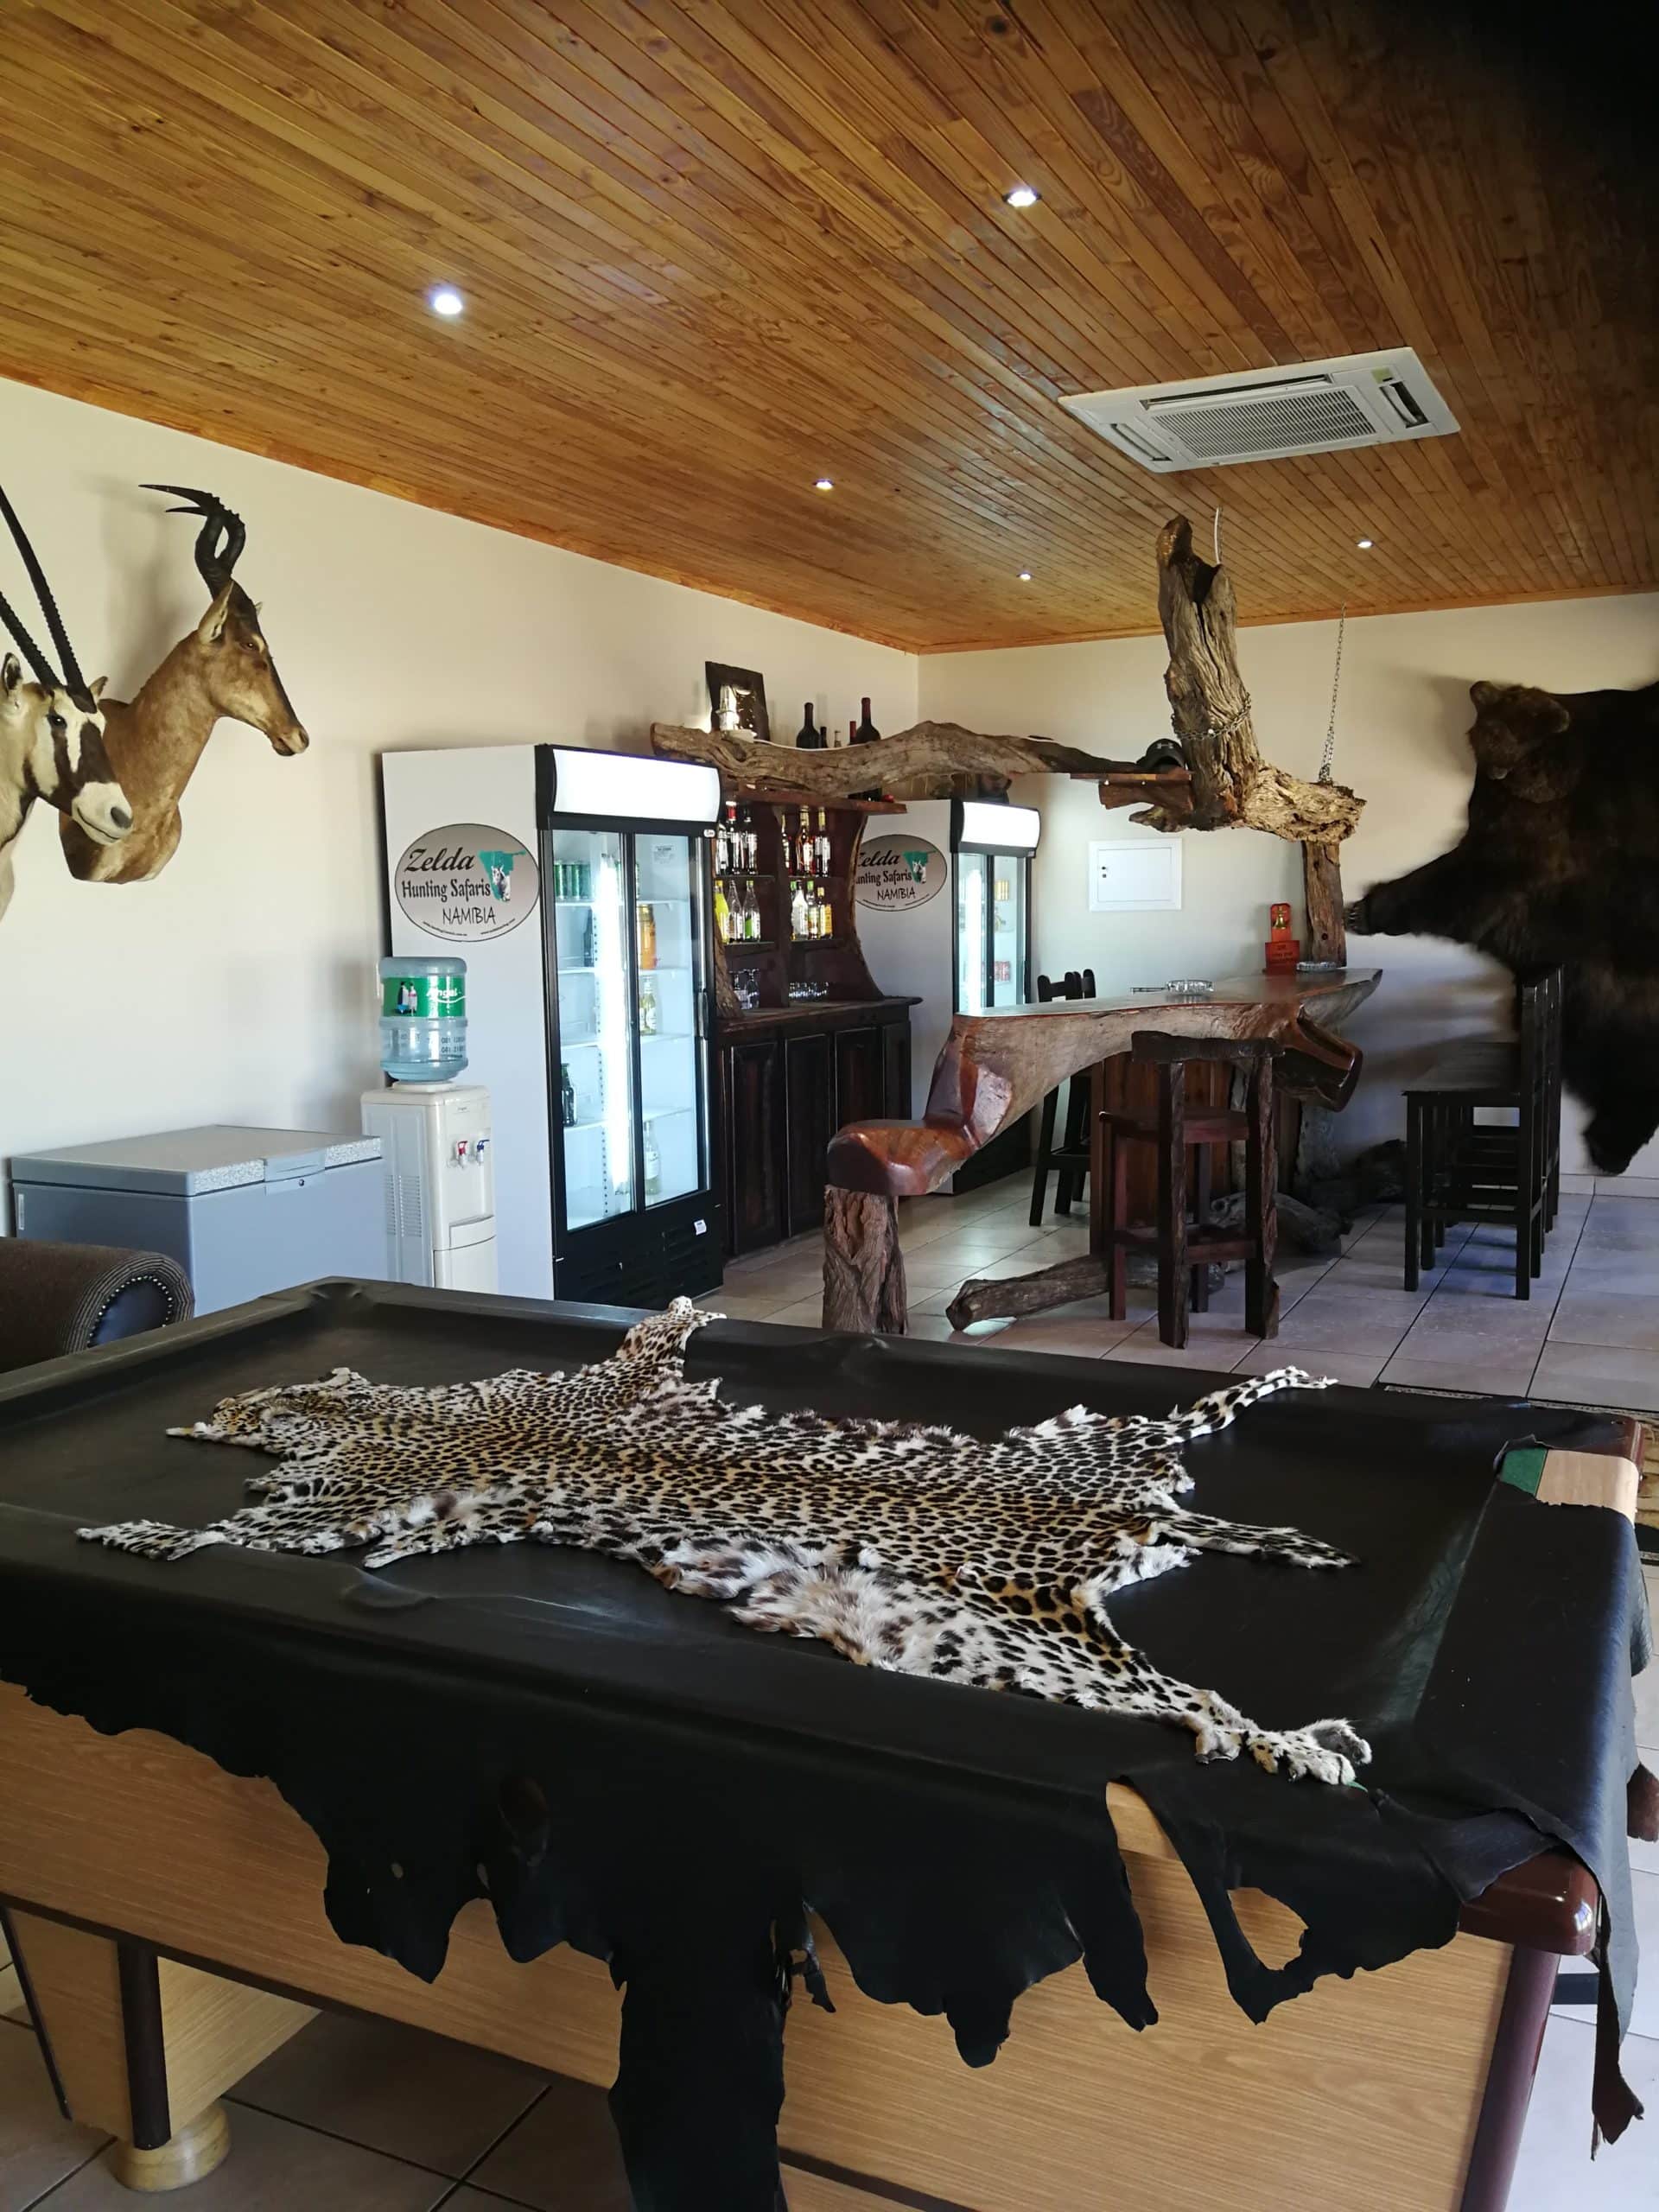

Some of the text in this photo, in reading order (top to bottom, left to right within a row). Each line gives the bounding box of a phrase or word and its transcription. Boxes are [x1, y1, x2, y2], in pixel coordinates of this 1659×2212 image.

[404, 847, 475, 872] Zelda
[856, 869, 912, 887] unting Safaris
[402, 878, 491, 902] Hunting Safaris
[877, 887, 916, 900] NAMIBIA
[442, 906, 497, 925] NAMIBIA
